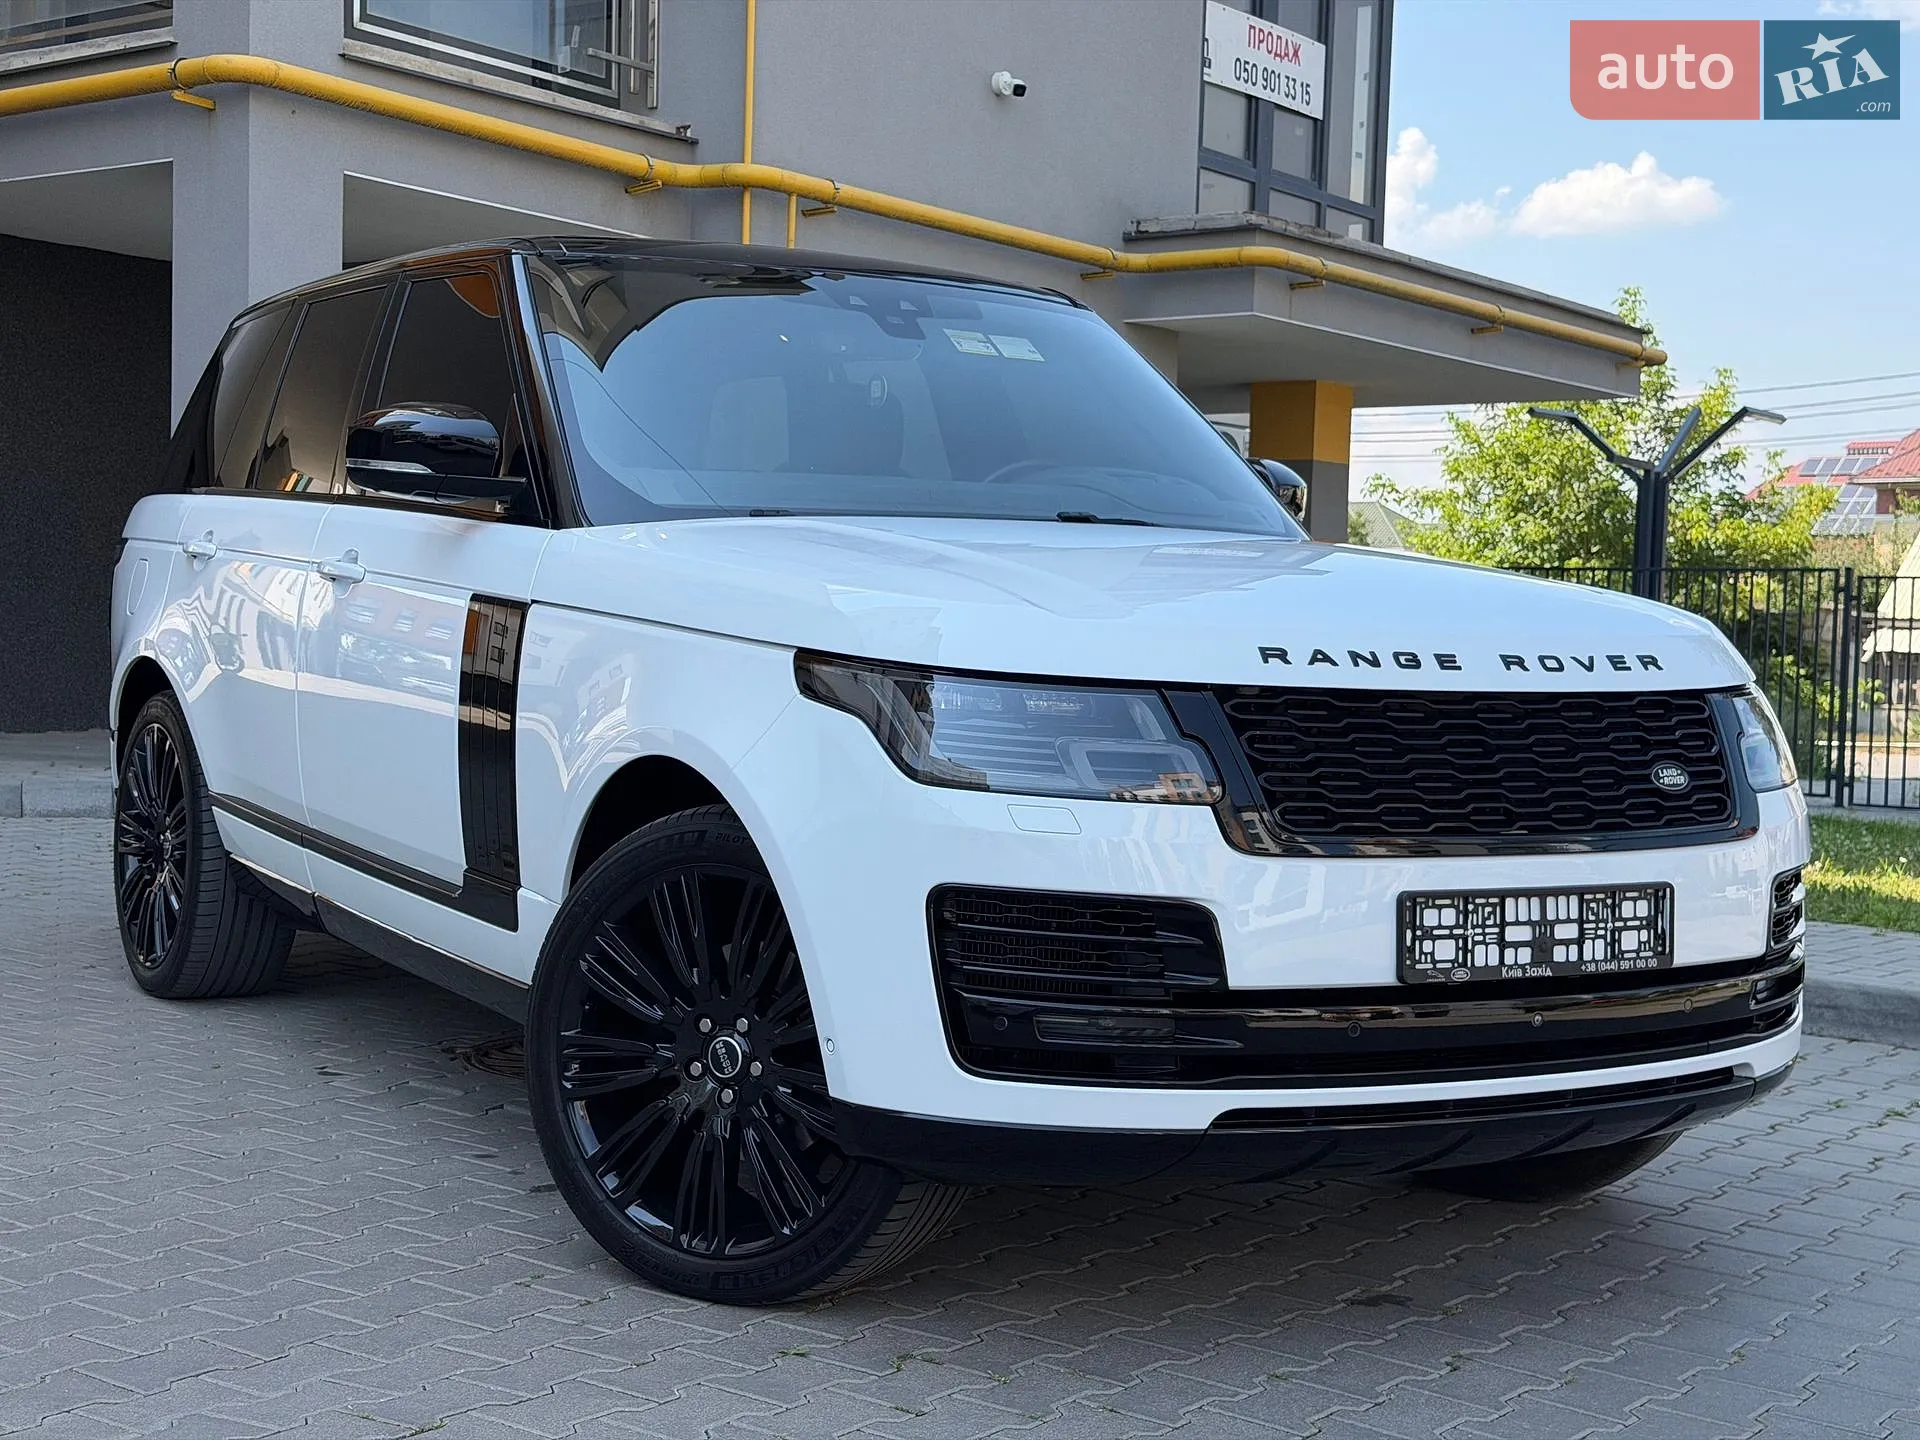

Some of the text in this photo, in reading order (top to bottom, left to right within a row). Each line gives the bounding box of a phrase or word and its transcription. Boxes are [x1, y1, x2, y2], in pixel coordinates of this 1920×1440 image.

[1247, 24, 1301, 66] ПРОДАЖ
[1234, 57, 1311, 106] 050 901 33 15
[1257, 646, 1664, 673] RANGE ROVER
[1658, 768, 1677, 777] LAND
[1663, 775, 1685, 785] ROVER
[1501, 965, 1523, 978] Київ
[1580, 958, 1658, 972] +38 (044) 591 00 00
